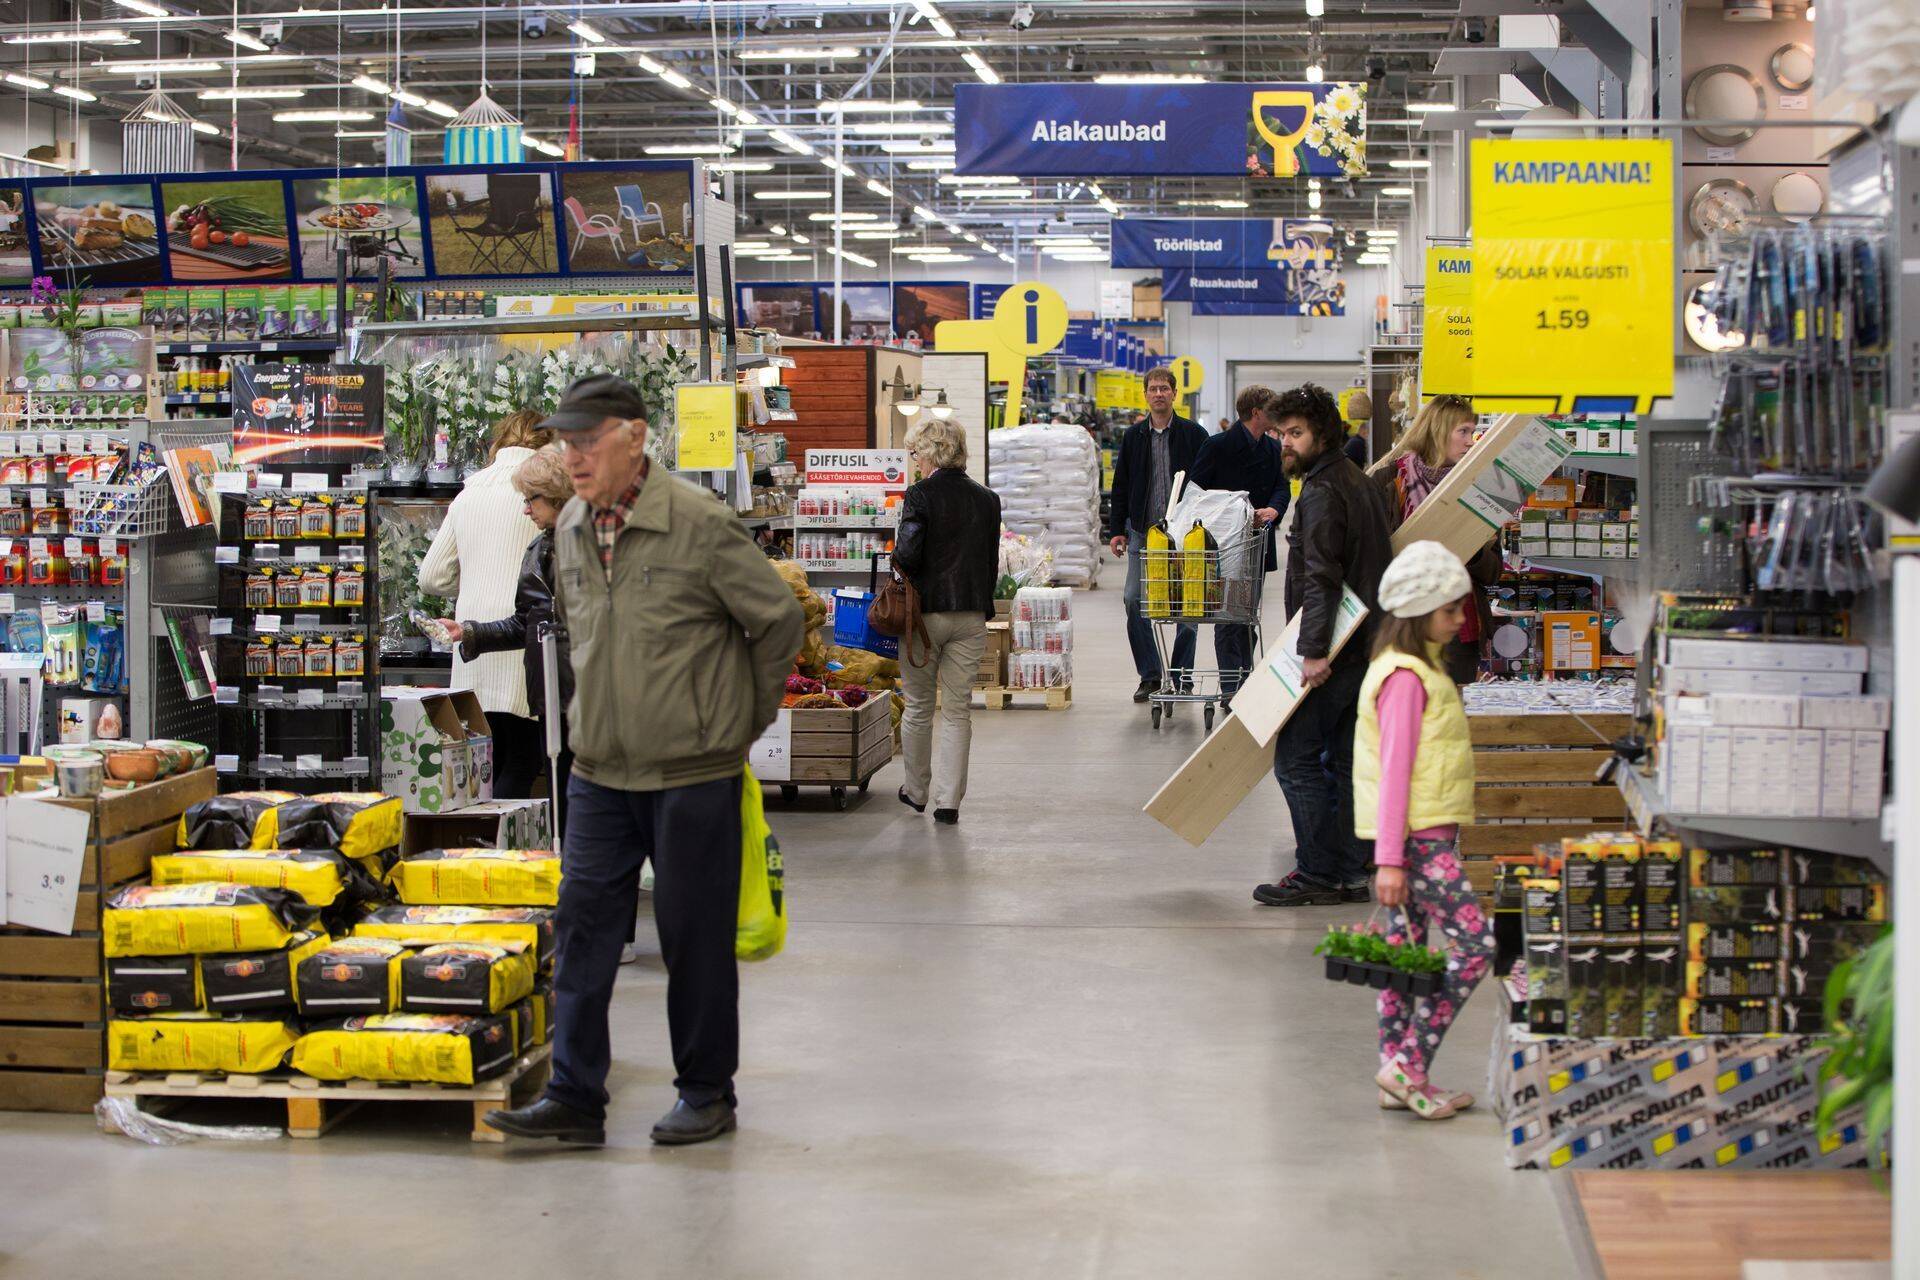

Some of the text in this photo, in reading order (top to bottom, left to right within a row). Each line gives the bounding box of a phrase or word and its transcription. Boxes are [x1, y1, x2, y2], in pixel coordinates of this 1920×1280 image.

[1032, 120, 1166, 141] Aiakaubad
[1494, 162, 1651, 183] KAMPAANIA!
[1154, 238, 1222, 251] Tööriistad
[1495, 265, 1629, 280] SOLAR VALGUSTI
[1190, 277, 1258, 289] Rauakaubad
[254, 373, 291, 384] Energizer
[303, 375, 363, 385] POWER SEAL
[339, 404, 363, 412] YEARS
[810, 455, 868, 466] DIFFUSIL
[1549, 1074, 1642, 1128] K-RAUTA
[1610, 1084, 1705, 1138] K-RAUTA
